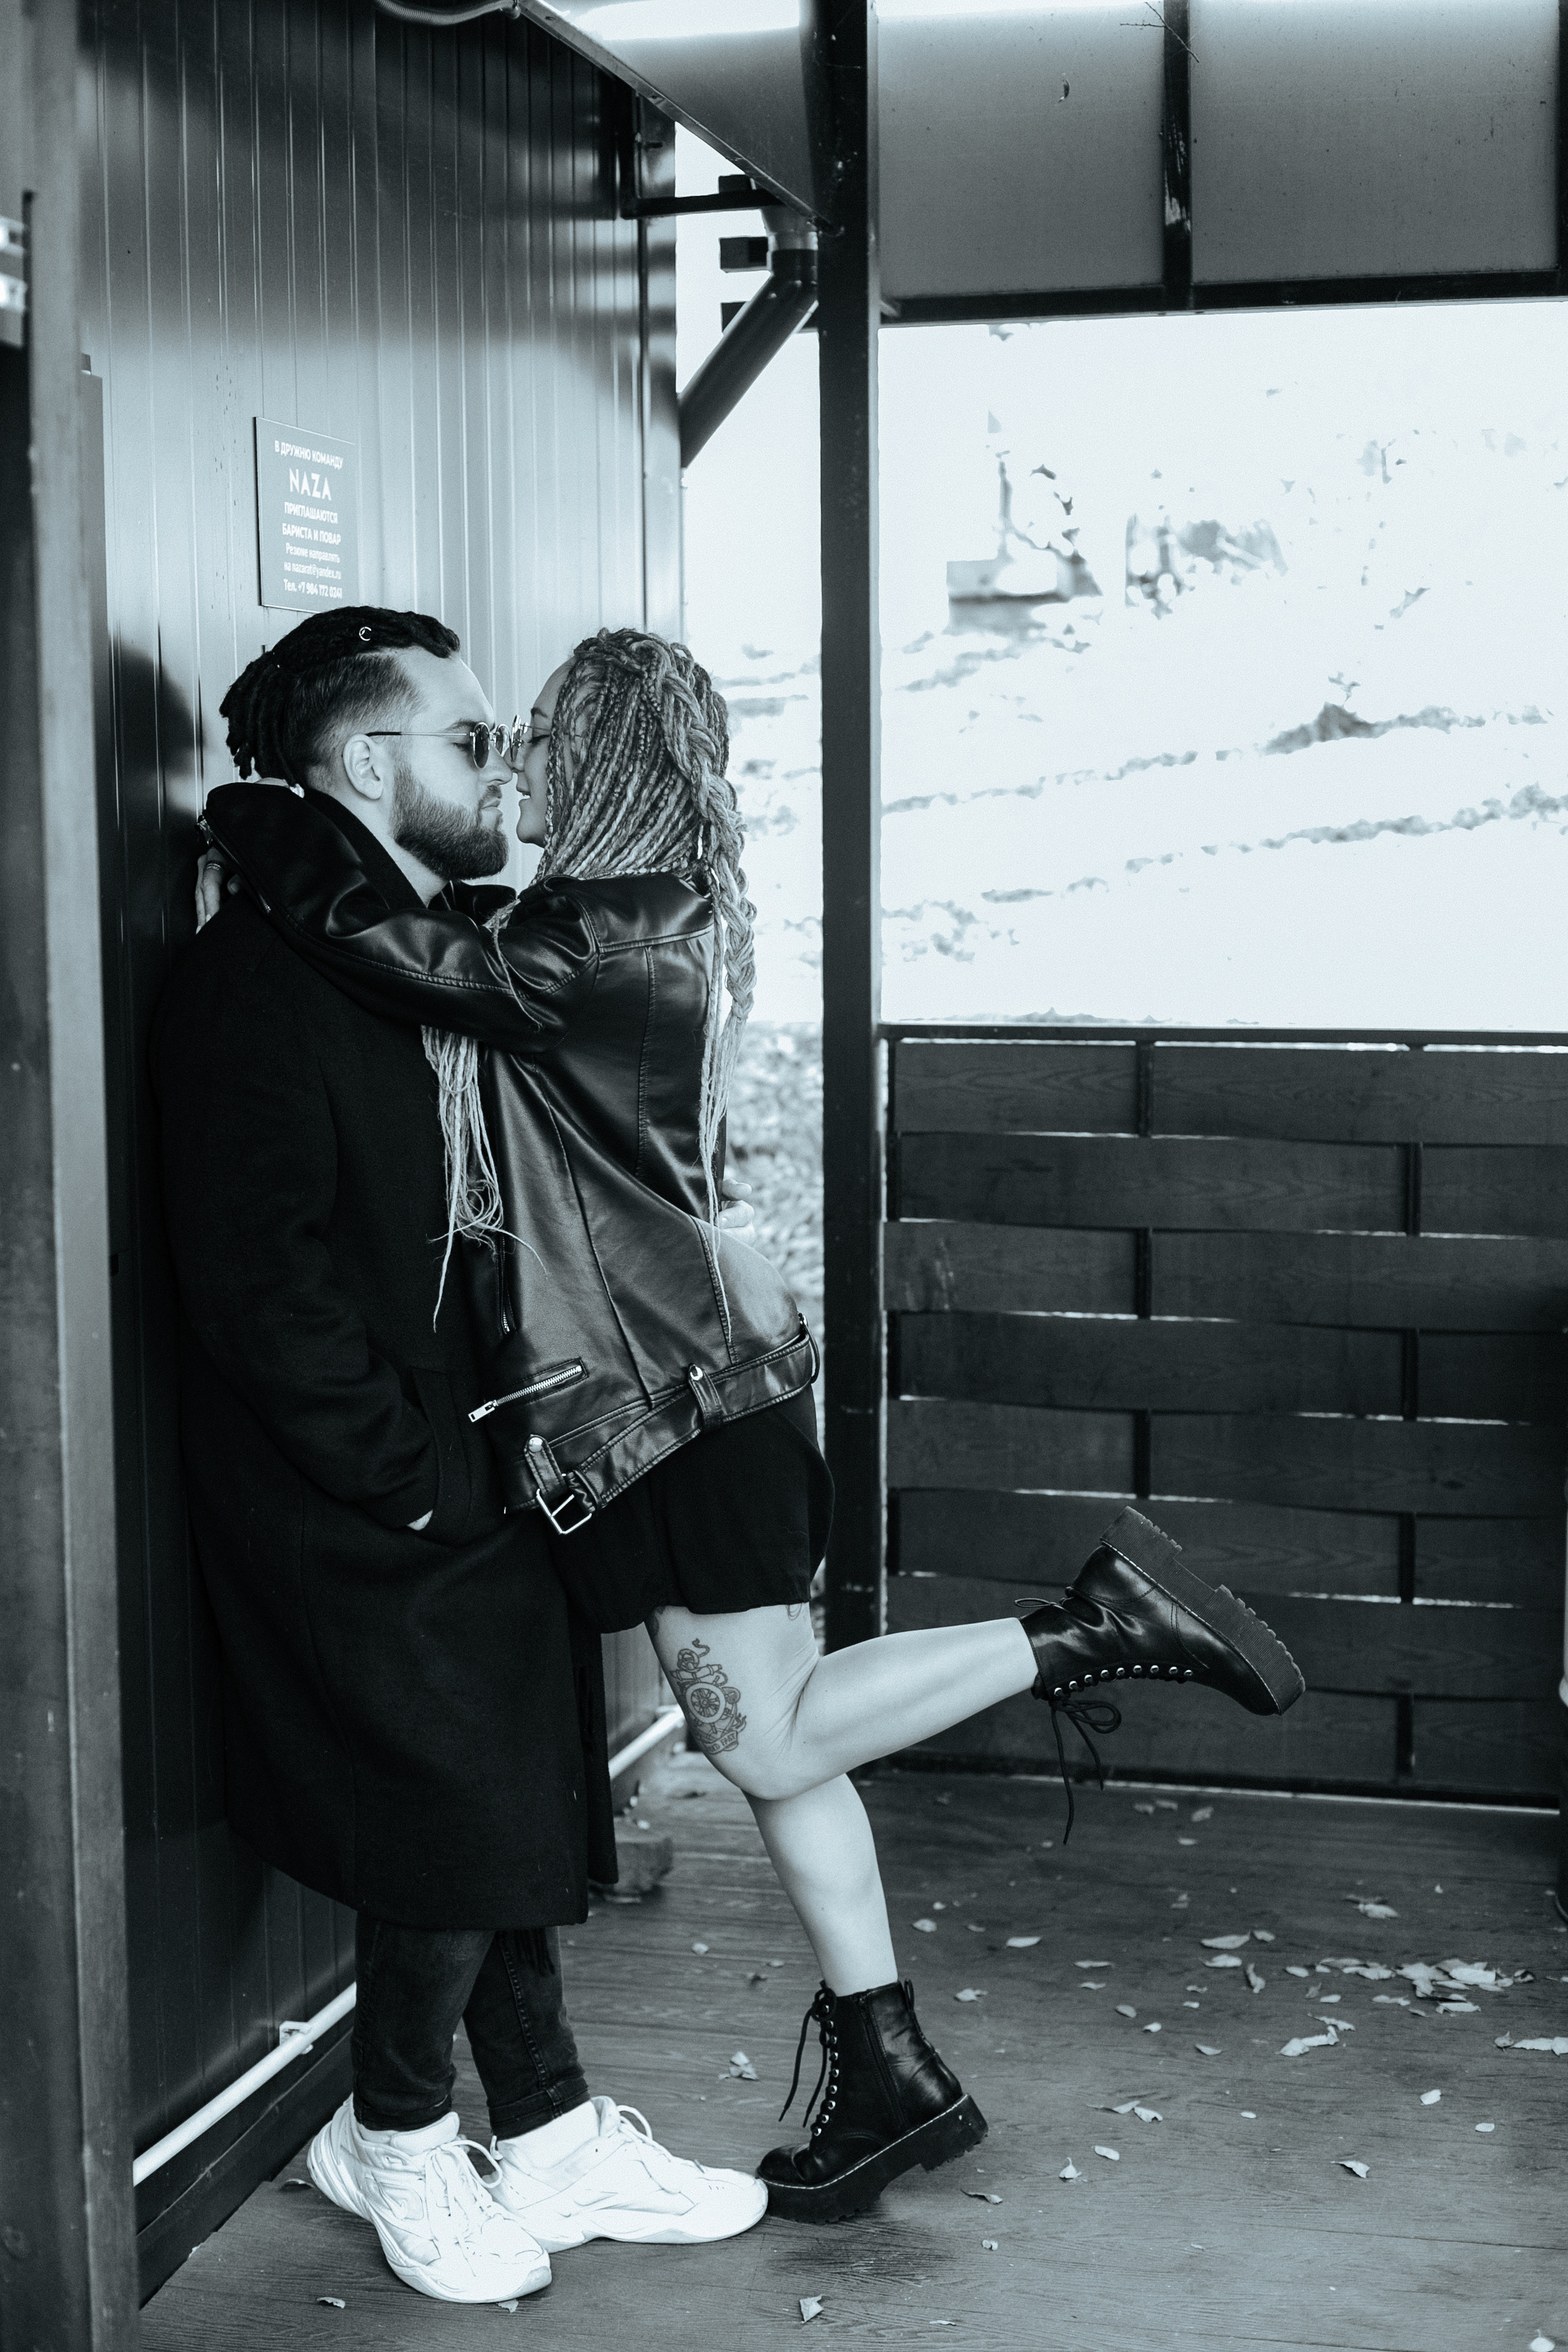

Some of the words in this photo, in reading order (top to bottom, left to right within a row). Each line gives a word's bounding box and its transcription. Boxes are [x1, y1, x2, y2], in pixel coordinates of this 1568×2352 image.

[274, 440, 280, 453] В
[312, 450, 344, 470] КОМАНДУ
[289, 467, 332, 501] NAZA
[284, 501, 338, 524] ПРИГЛАШАЮТСЯ
[282, 522, 312, 541] БАРИСТА
[313, 529, 318, 541] И
[319, 530, 341, 546] ПОВАР
[285, 542, 309, 558] Резюме
[309, 549, 341, 564] направлять
[284, 562, 292, 571] на
[283, 578, 297, 592] Тел.
[298, 581, 306, 594] +7
